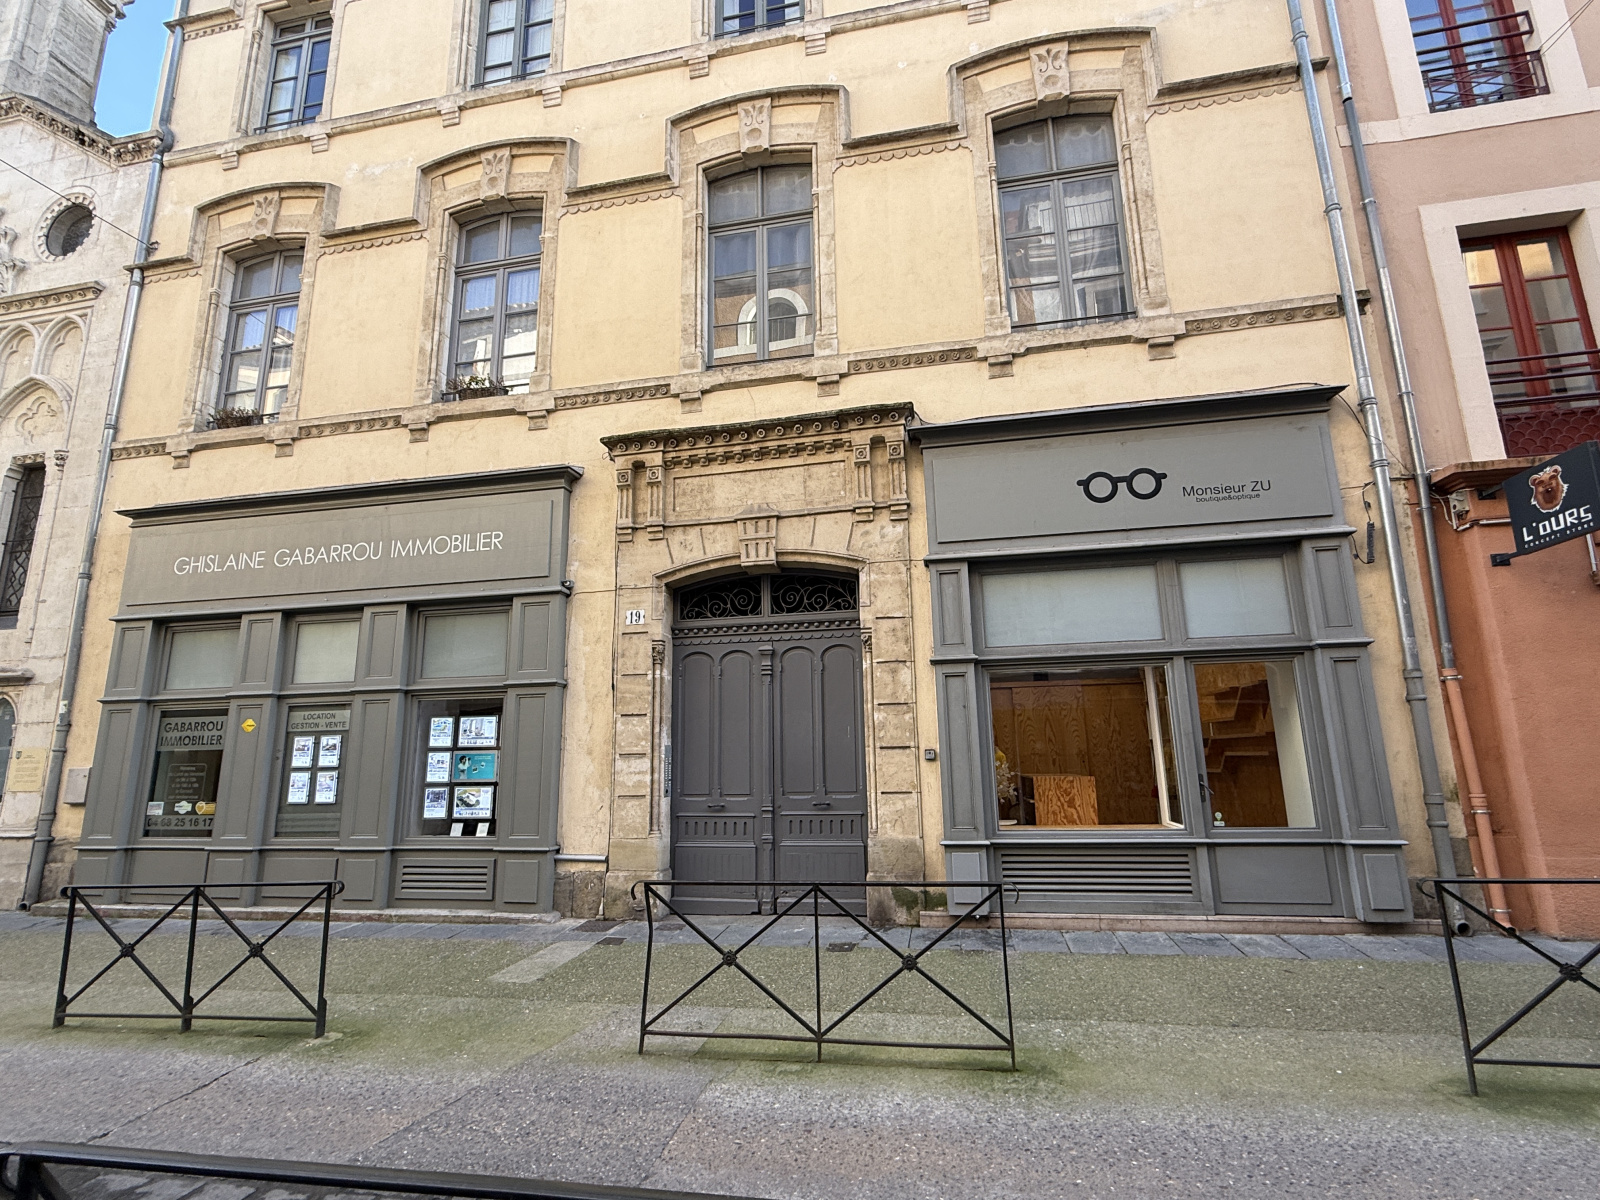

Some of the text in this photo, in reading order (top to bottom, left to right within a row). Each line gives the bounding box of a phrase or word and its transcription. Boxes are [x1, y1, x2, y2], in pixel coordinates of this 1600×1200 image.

[1182, 479, 1271, 497] Monsieur ZU
[1195, 492, 1261, 503] boutique&optique
[1524, 521, 1594, 549] CONCEPT STORE
[173, 531, 504, 575] GHISLAINE GABARROU IMMOBILIER
[629, 610, 641, 624] 19
[303, 712, 336, 720] LOCATION
[164, 721, 224, 733] GABARROU
[290, 722, 321, 730] GESTION
[160, 734, 223, 747] IMMOBILIER
[174, 817, 186, 827] 25
[188, 817, 200, 827] 16
[202, 817, 214, 827] 17
